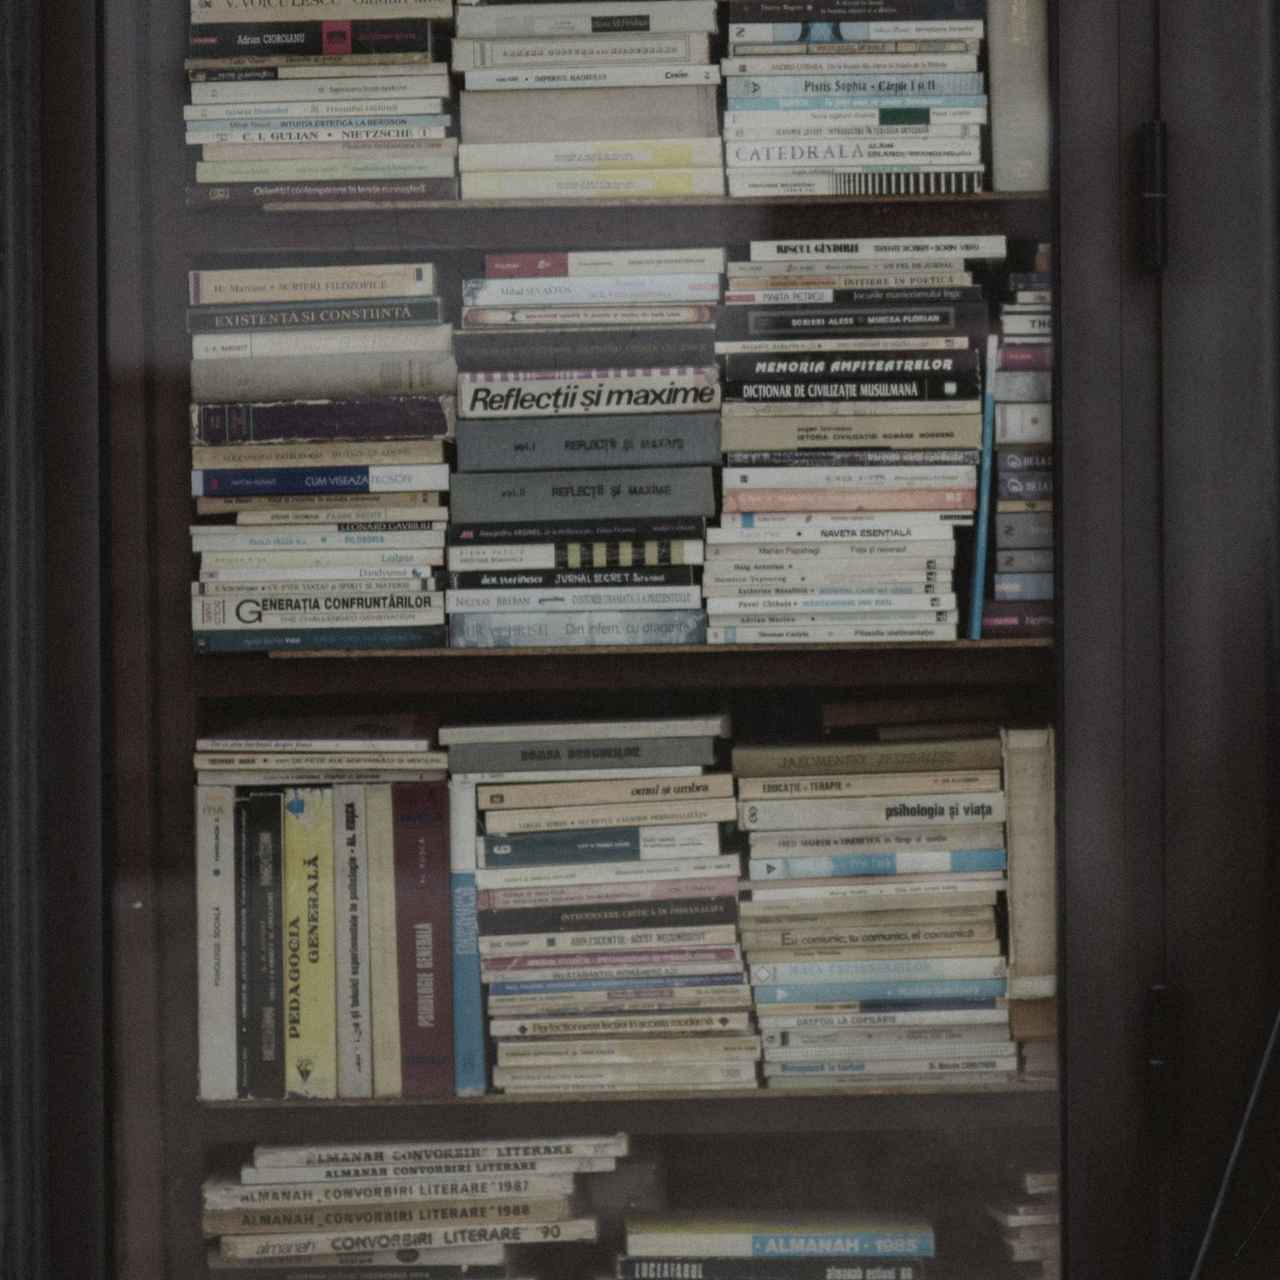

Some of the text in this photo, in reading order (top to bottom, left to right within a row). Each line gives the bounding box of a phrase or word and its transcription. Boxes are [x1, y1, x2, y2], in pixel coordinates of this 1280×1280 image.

[237, 35, 260, 45] Adrian
[342, 129, 413, 139] NIETZSCHE
[736, 145, 864, 161] CATEDRALA
[763, 293, 792, 302] MARTA
[755, 359, 952, 374] MEMORIA AMFITEATRELOR
[470, 382, 714, 412] Reflecții și maxime
[743, 382, 918, 400] DICȚIONAR DE CIVILIZAȚIE MUSULMANĂ
[235, 595, 431, 624] GENERAȚIA CONFRUNTĂRILOR
[885, 803, 993, 820] psihologia și viața
[303, 855, 319, 963] GENERALĂ
[290, 917, 300, 1038] PEDAGOGIA
[764, 1237, 859, 1254] ALMANAH
